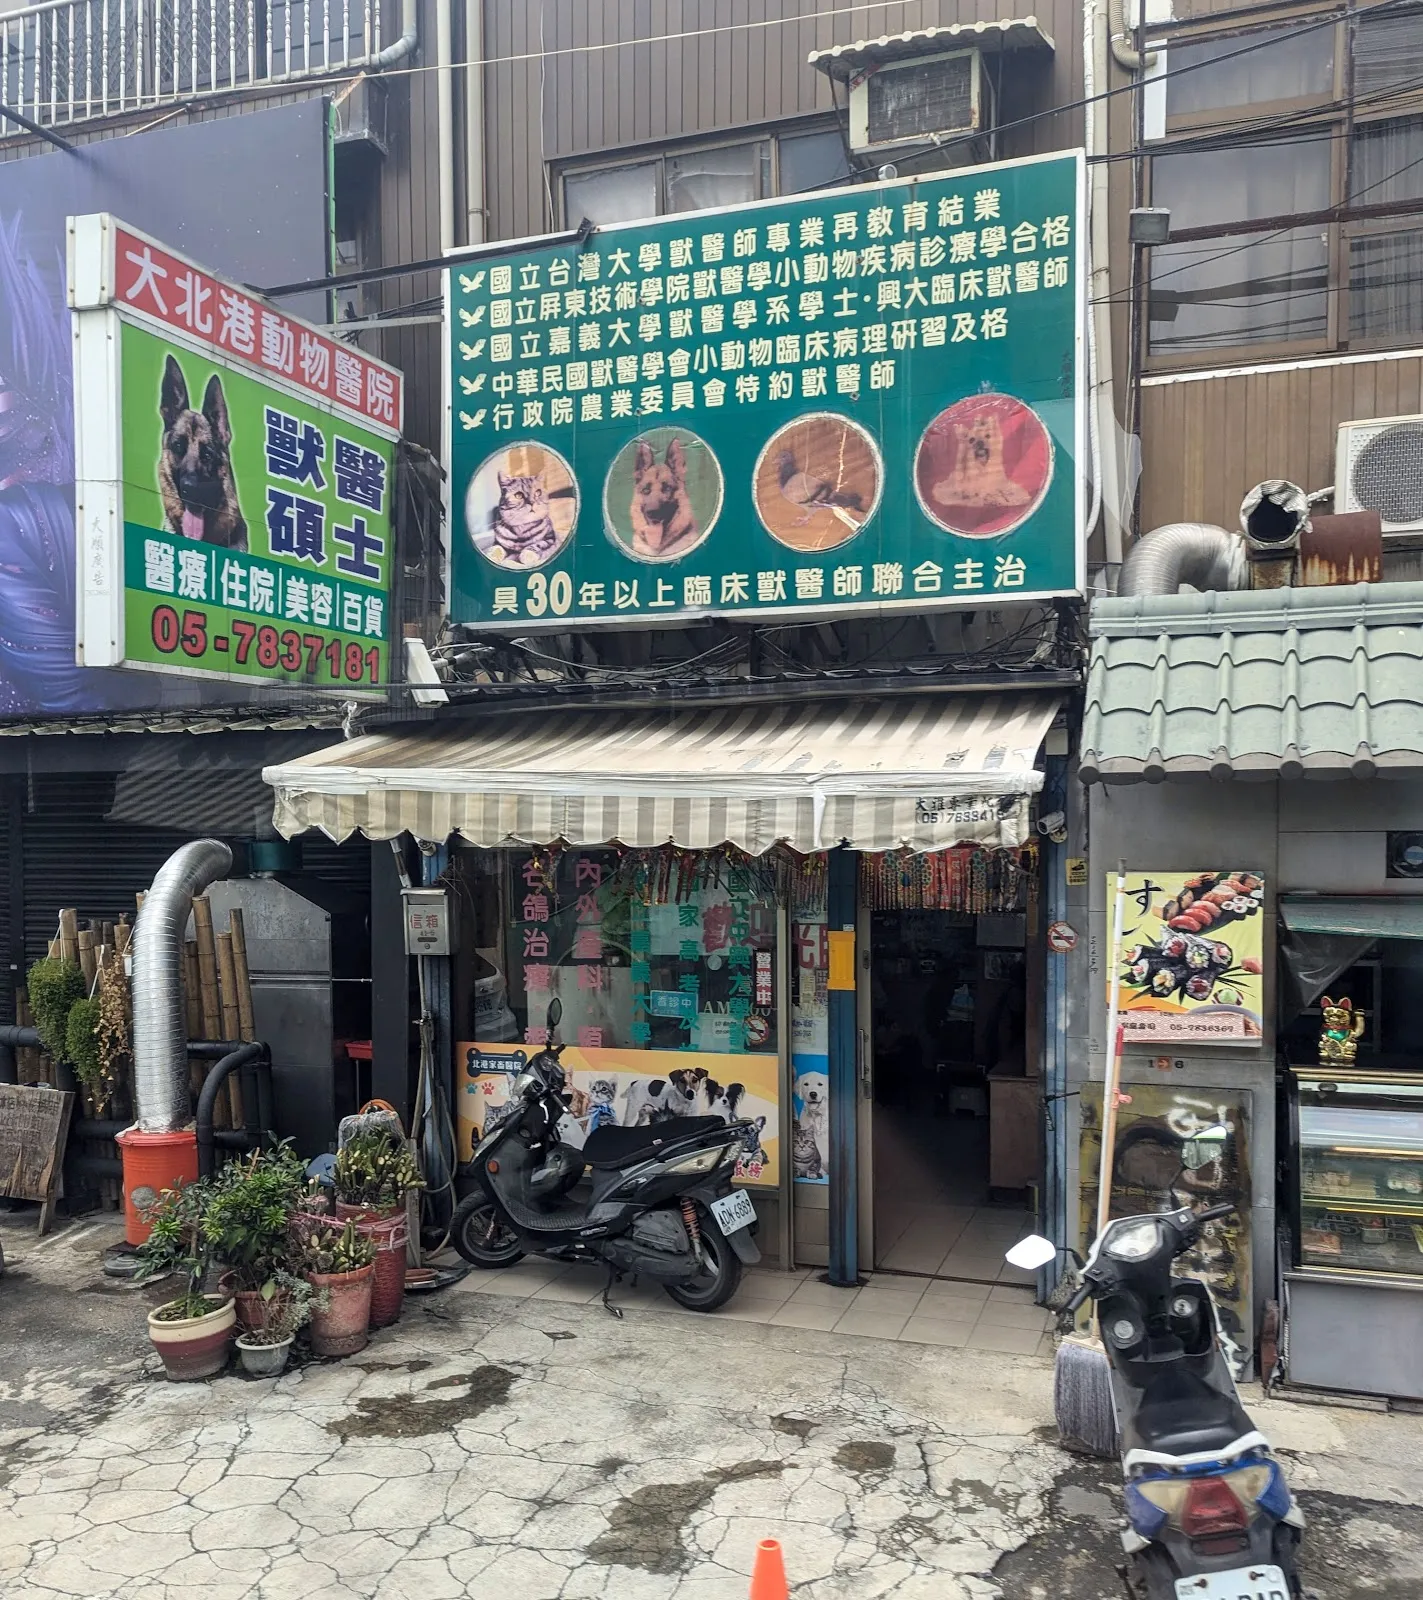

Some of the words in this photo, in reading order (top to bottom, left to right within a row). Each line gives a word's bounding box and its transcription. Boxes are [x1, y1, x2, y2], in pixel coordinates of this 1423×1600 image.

[490, 188, 1001, 295] 國立台灣大學獸醫師專業再教育結業
[490, 215, 1071, 328] 國立屏東技術學院獸醫學小動物疾病診療學合格
[125, 246, 395, 422] 大北港動物醫院
[492, 359, 896, 431] 行政院農業委員會特約獸醫師
[151, 605, 381, 685] 05-7837181
[756, 952, 771, 1005] 營業中
